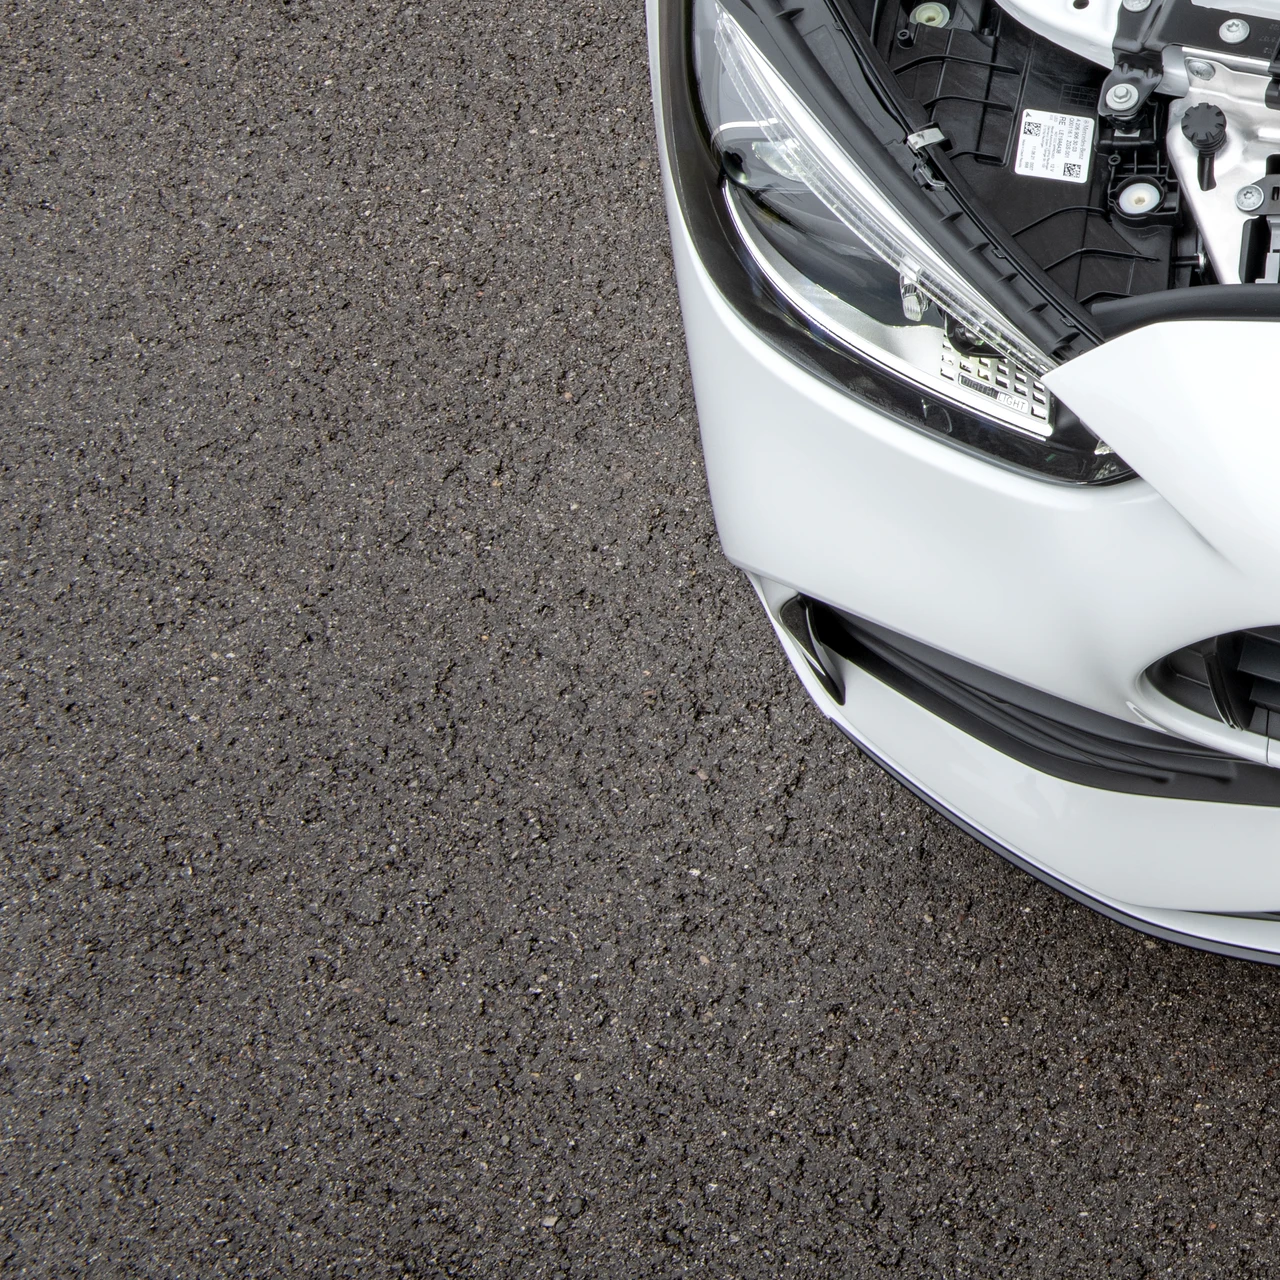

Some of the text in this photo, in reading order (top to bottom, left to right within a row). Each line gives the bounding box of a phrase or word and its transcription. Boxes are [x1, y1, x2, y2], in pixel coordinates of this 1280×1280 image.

[1059, 117, 1066, 125] RE
[1079, 125, 1089, 160] Mercedes-Benz
[998, 391, 1026, 410] LIGHT
